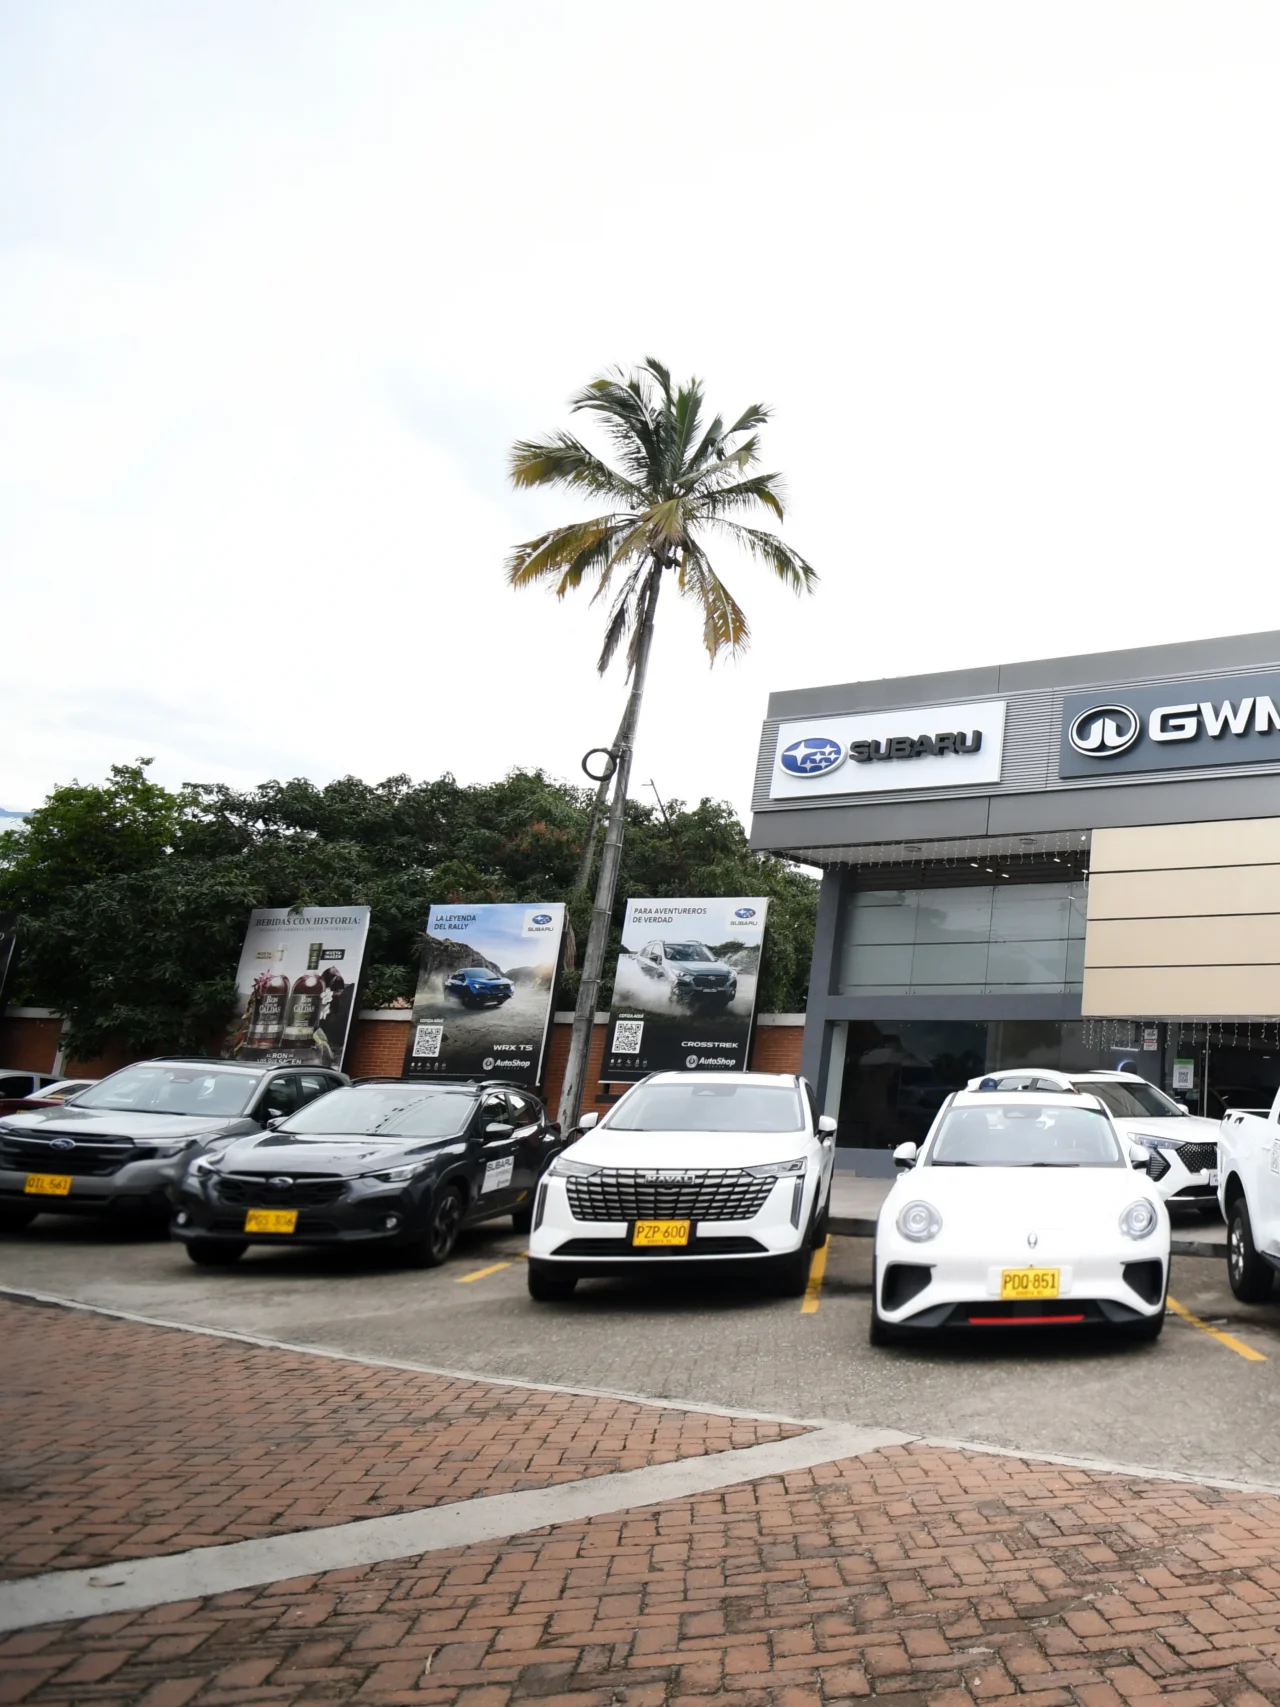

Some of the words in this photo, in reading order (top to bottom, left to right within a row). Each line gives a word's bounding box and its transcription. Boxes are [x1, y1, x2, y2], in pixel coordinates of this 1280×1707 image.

[849, 730, 983, 763] SUBARU
[255, 917, 291, 926] BEBIDAS
[293, 917, 311, 925] CON
[313, 916, 361, 925] HISTORIA:
[494, 1059, 531, 1068] AutoShop
[698, 1056, 736, 1067] AutoShop
[647, 1175, 693, 1183] HAVAL
[636, 1225, 660, 1239] PZP
[662, 1225, 687, 1239] 600
[1003, 1274, 1029, 1290] PDQ
[1032, 1273, 1056, 1289] 851
